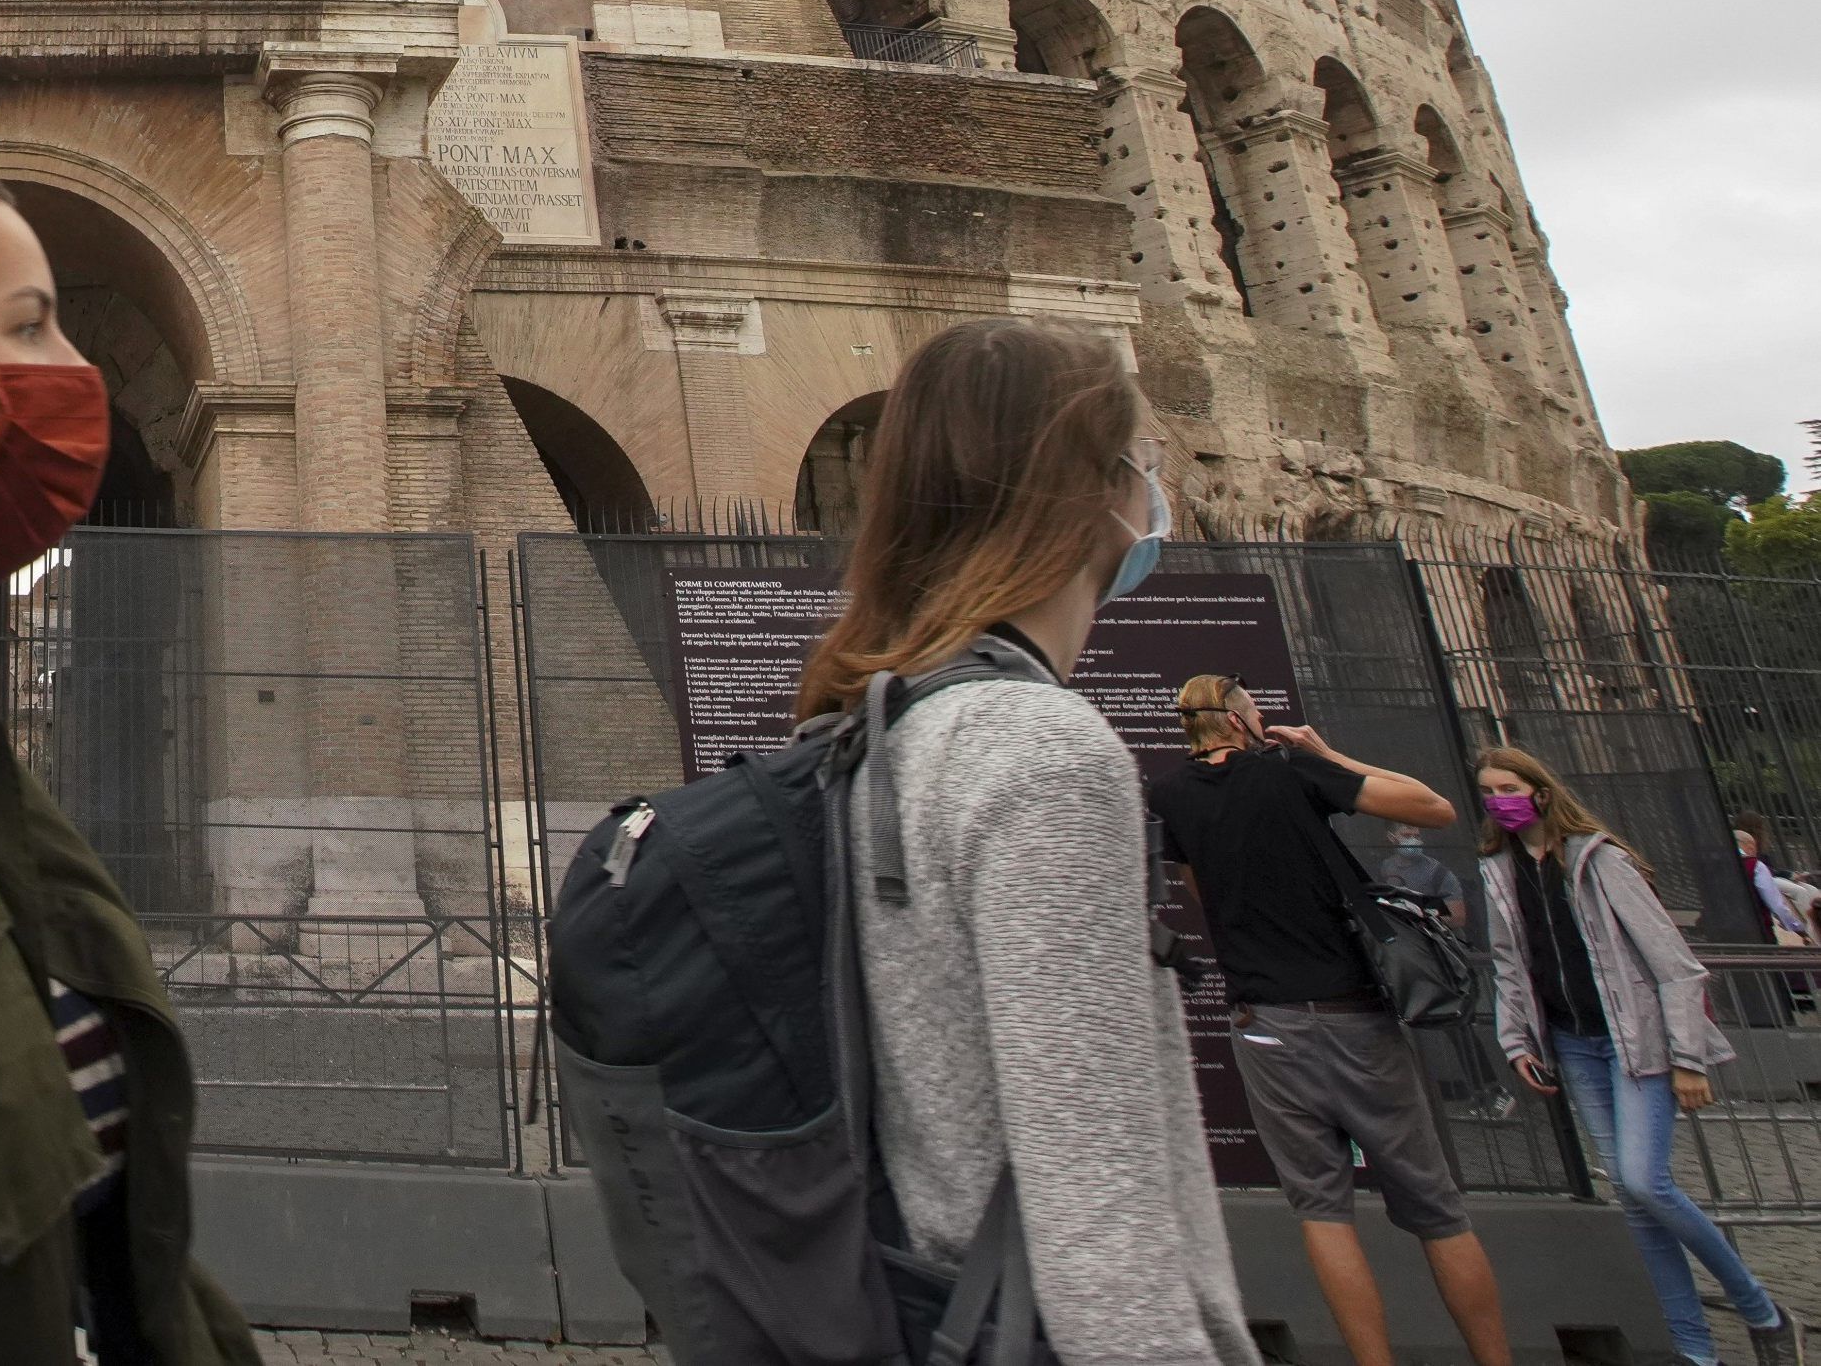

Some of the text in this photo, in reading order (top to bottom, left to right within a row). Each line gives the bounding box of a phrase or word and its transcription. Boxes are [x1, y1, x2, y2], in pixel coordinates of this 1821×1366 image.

[478, 45, 538, 59] FLAVIVM
[467, 92, 495, 103] PONT
[500, 93, 526, 104] MAX
[473, 117, 501, 128] PONT
[506, 118, 532, 129] MAX
[438, 144, 557, 165] PONT MAX
[519, 167, 581, 178] CONVERSAM
[456, 178, 538, 192] FATISCENTEM
[521, 193, 582, 207] CVRASSET
[675, 580, 703, 588] NORME
